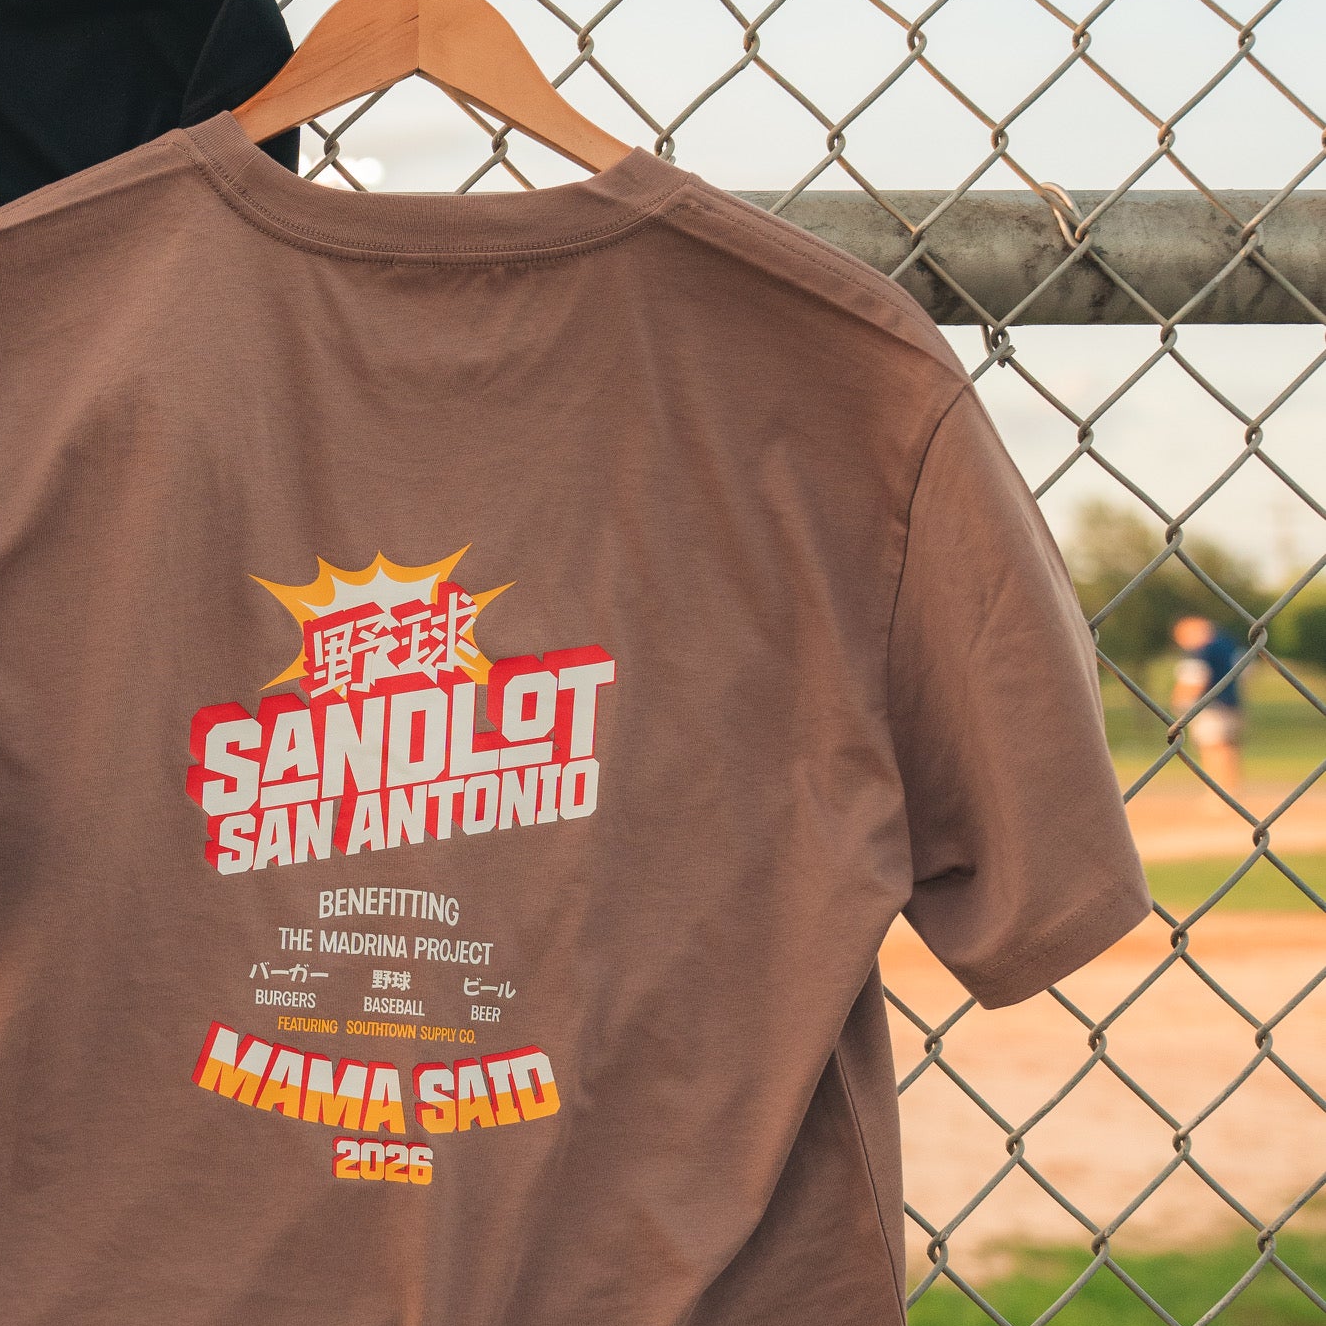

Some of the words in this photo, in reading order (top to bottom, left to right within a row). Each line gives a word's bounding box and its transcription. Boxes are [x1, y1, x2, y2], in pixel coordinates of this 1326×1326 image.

[309, 592, 480, 698] 野球
[202, 660, 616, 817] SANDLOT
[217, 799, 332, 875] SAN
[345, 758, 600, 856] ANTONIO
[318, 887, 460, 926] BENEFITTING
[278, 927, 313, 952] THE
[319, 930, 408, 959] MADRINA
[414, 936, 494, 966] PROJECT
[249, 961, 329, 984] バーガー
[372, 969, 412, 991] 野球
[463, 977, 517, 1000] ビール
[255, 989, 316, 1009] BURGERS
[363, 996, 425, 1017] BASEBALL
[470, 1005, 501, 1023] BEER
[277, 1016, 338, 1035] FEATURING
[346, 1020, 416, 1040] SOUTHTOWN
[420, 1025, 457, 1044] SUPPLY
[458, 1028, 477, 1044] CO.
[197, 1026, 407, 1134] MAMA
[418, 1051, 561, 1134] SAID
[335, 1139, 434, 1186] 2026
